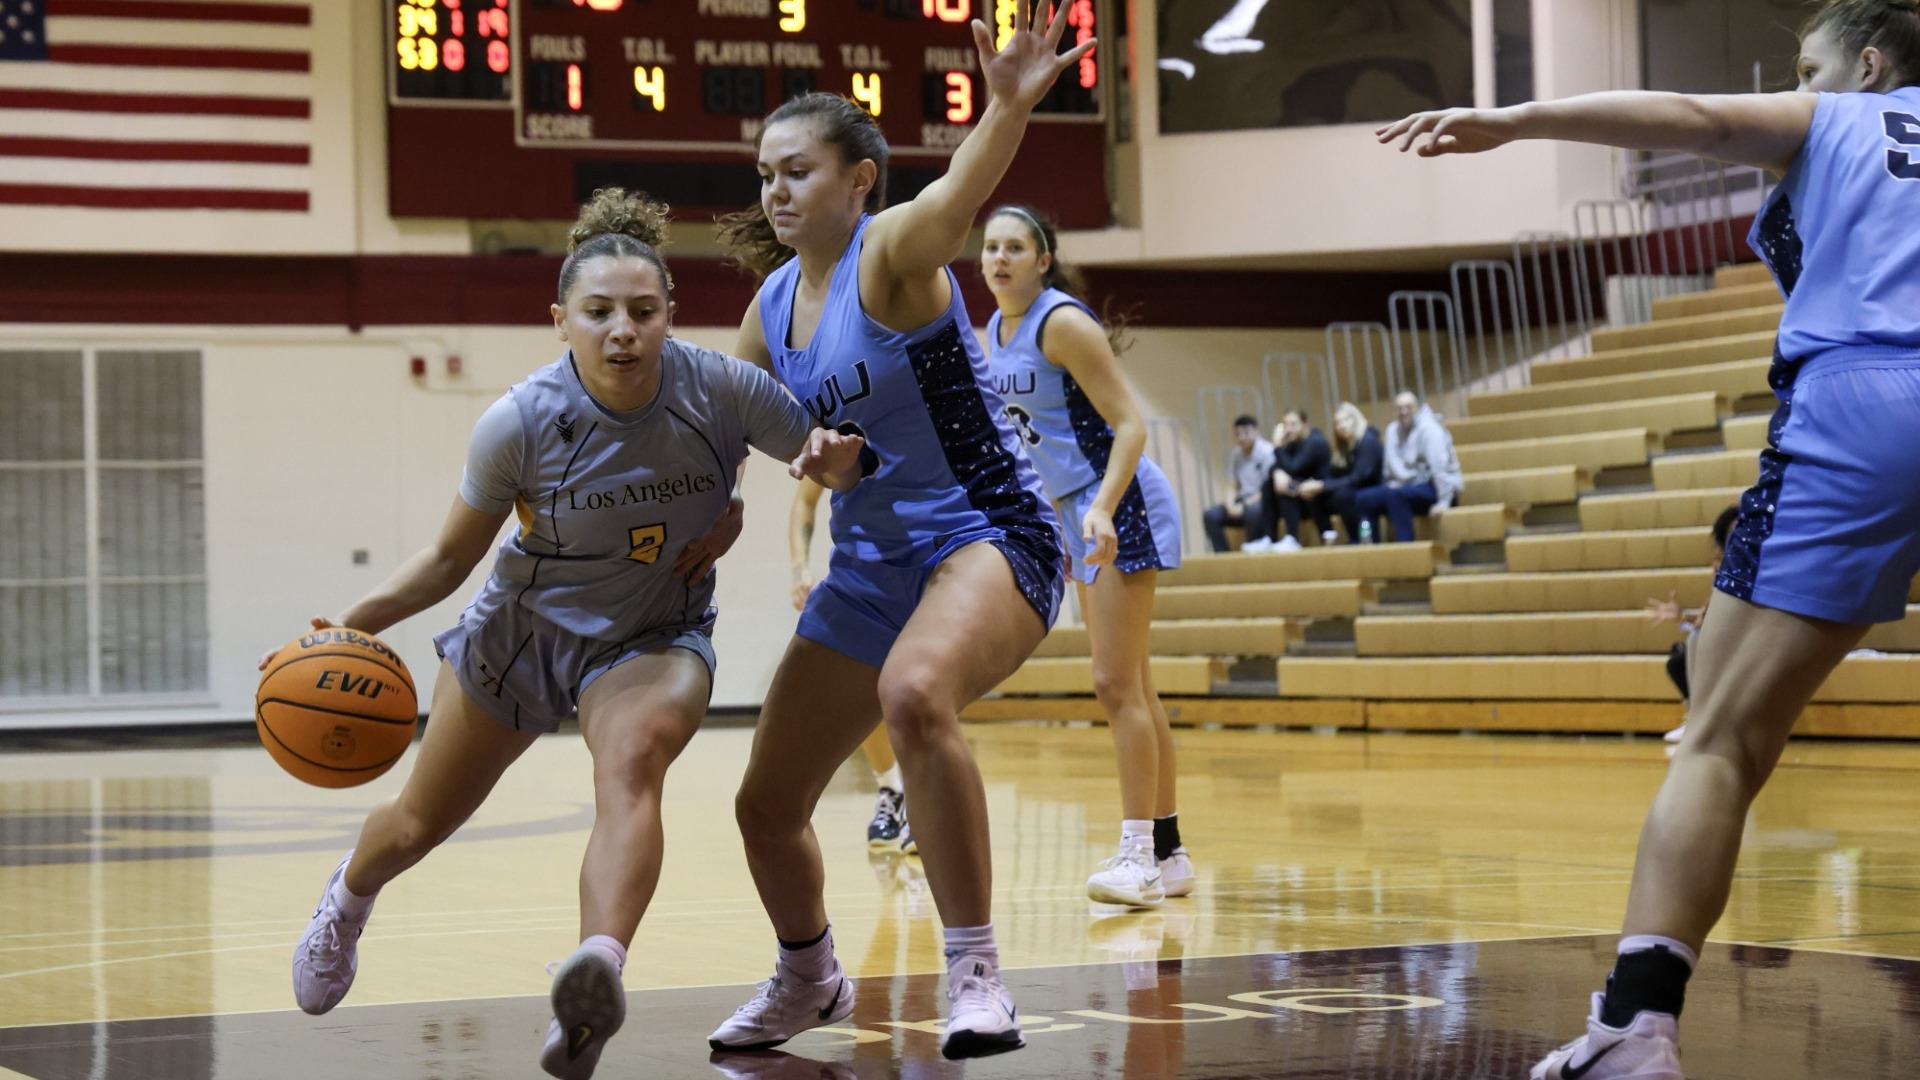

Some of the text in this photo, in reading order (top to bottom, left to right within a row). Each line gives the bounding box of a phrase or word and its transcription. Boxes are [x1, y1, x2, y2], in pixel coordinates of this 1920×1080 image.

[529, 34, 587, 61] FOULS
[694, 40, 824, 69] PLAYER FOUL
[924, 47, 976, 71] FOULS
[566, 64, 582, 111] 1
[633, 66, 665, 112] 4
[851, 72, 881, 117] 4
[945, 71, 973, 123] 3
[526, 114, 594, 140] SCORE
[568, 471, 717, 512] Los Angeles
[622, 520, 667, 565] 2
[315, 670, 384, 700] EVO
